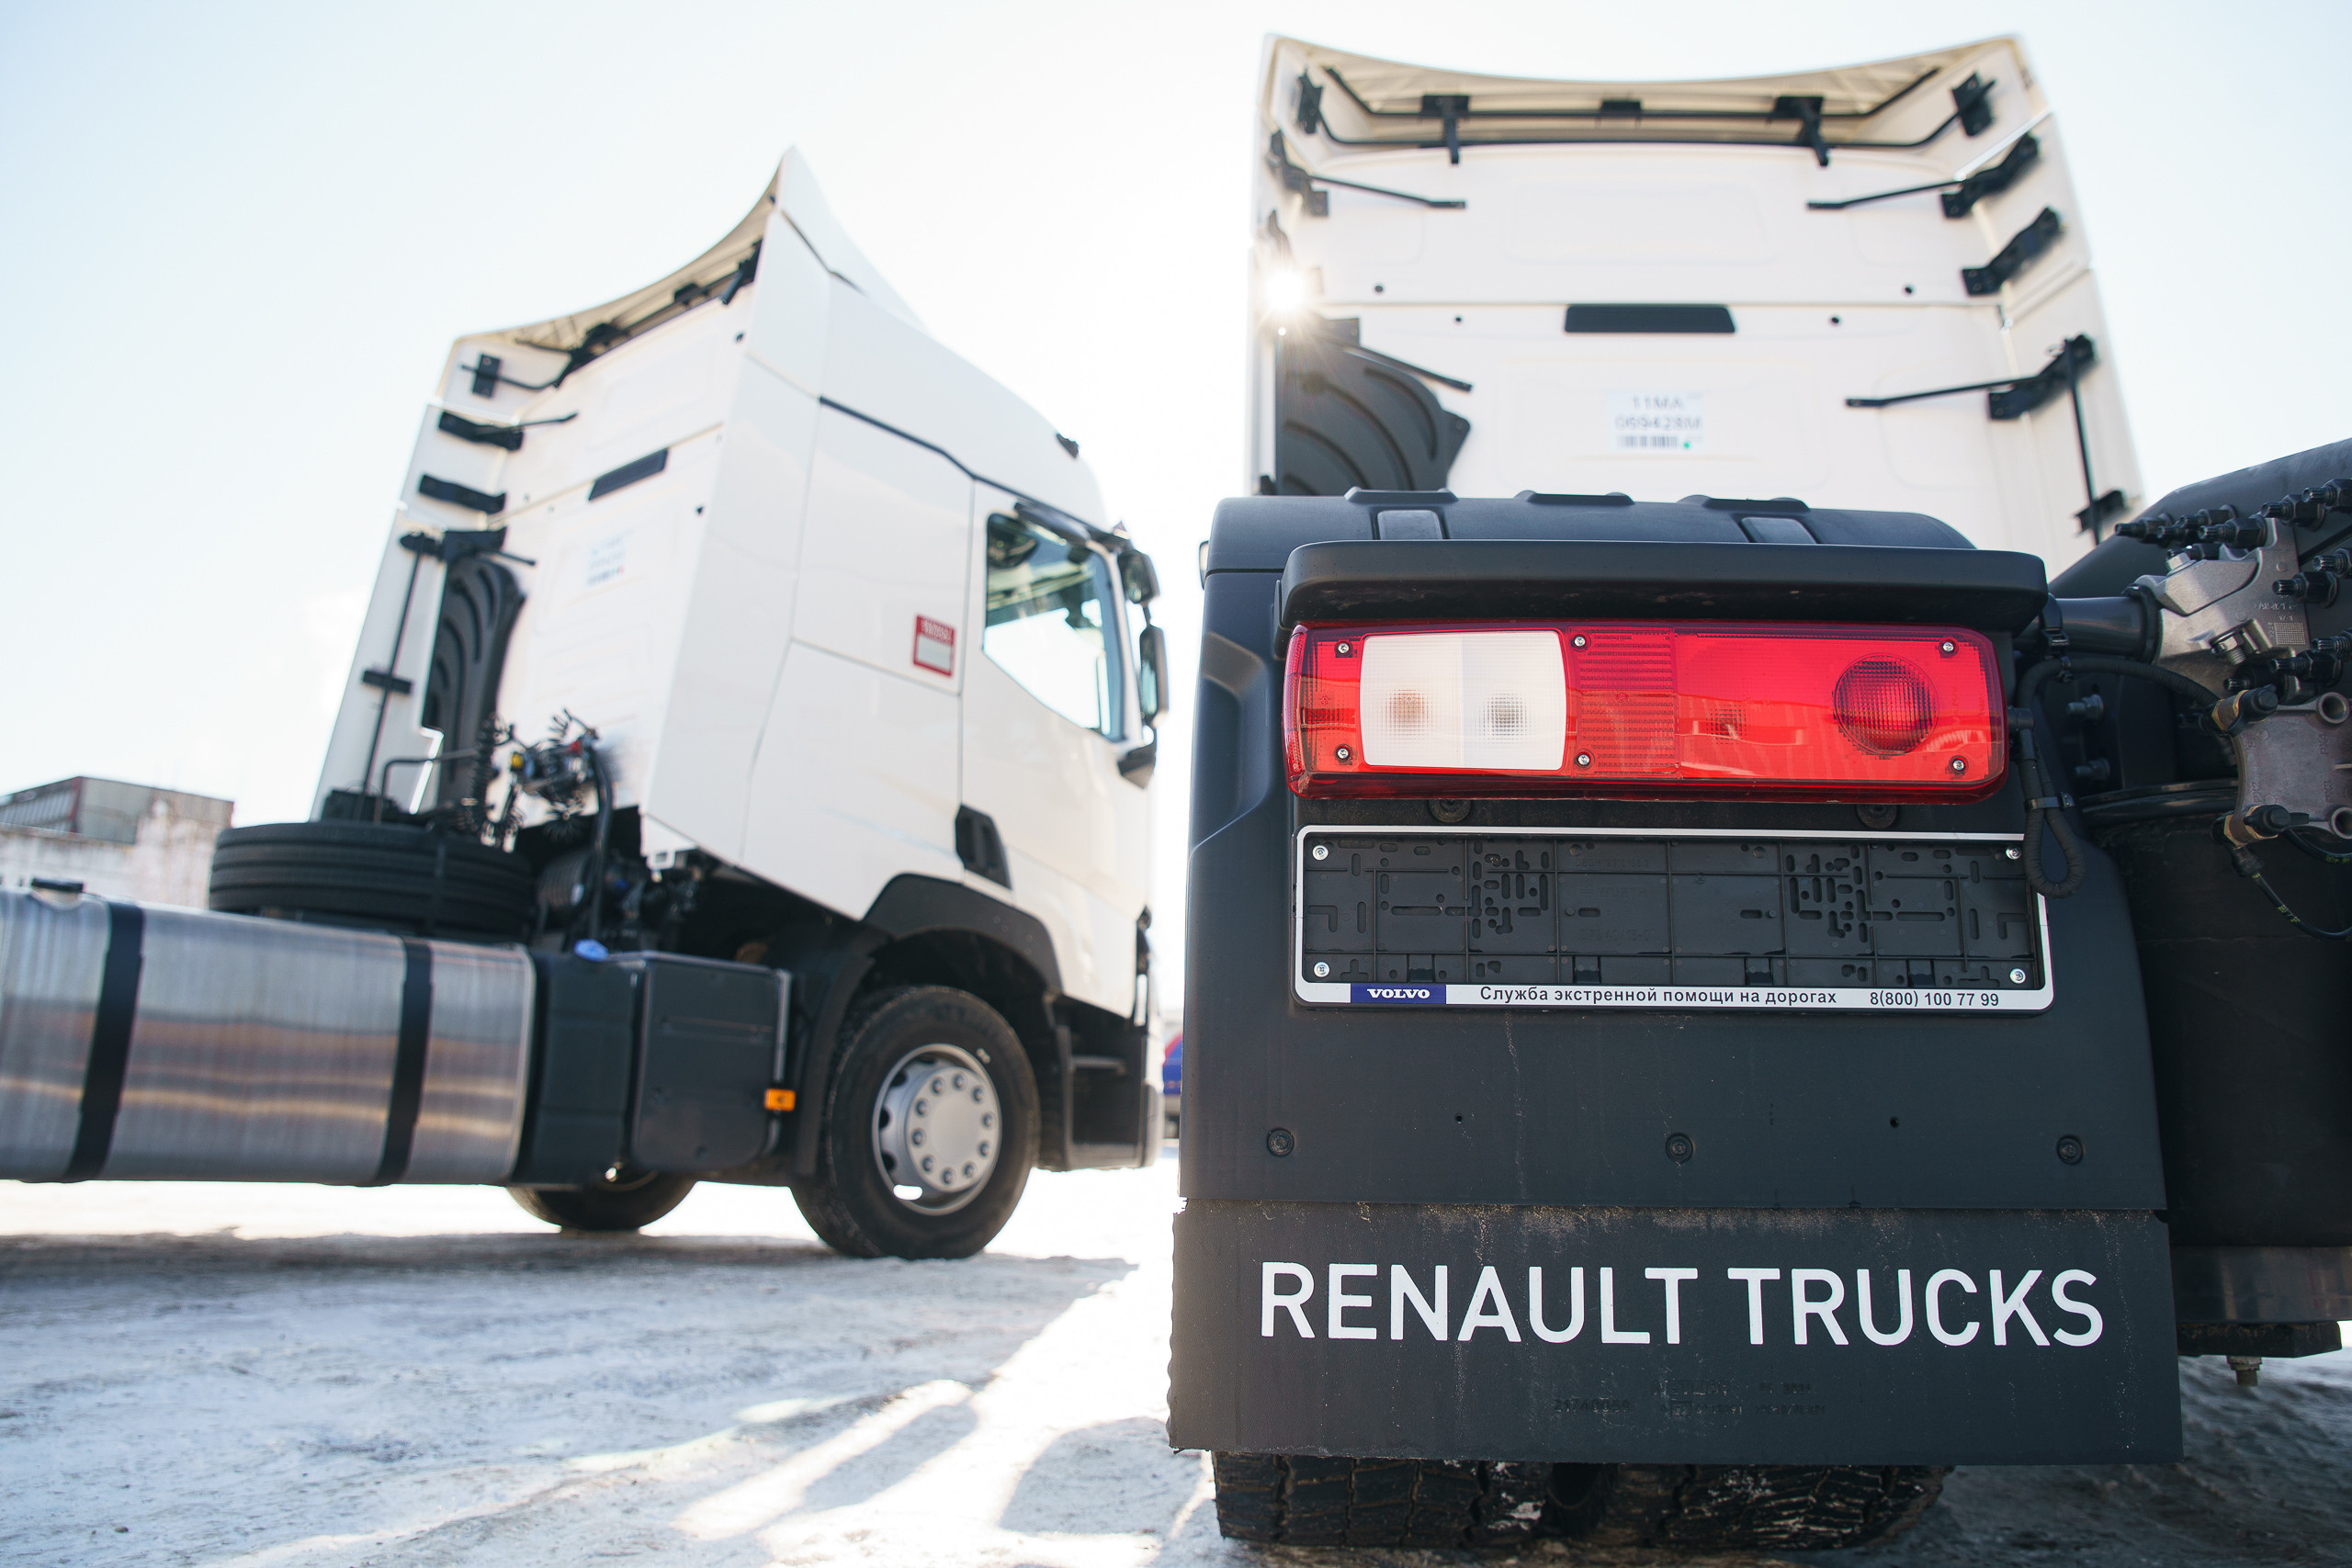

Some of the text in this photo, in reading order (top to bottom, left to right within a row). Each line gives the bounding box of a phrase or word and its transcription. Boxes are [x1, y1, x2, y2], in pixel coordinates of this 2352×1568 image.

[1366, 988, 1430, 999] VOLVO
[1480, 986, 1999, 1007] Служба экстренной помощи на дорогах 8(800) 100 77 99
[1261, 1261, 2103, 1347] RENAULT TRUCKS
